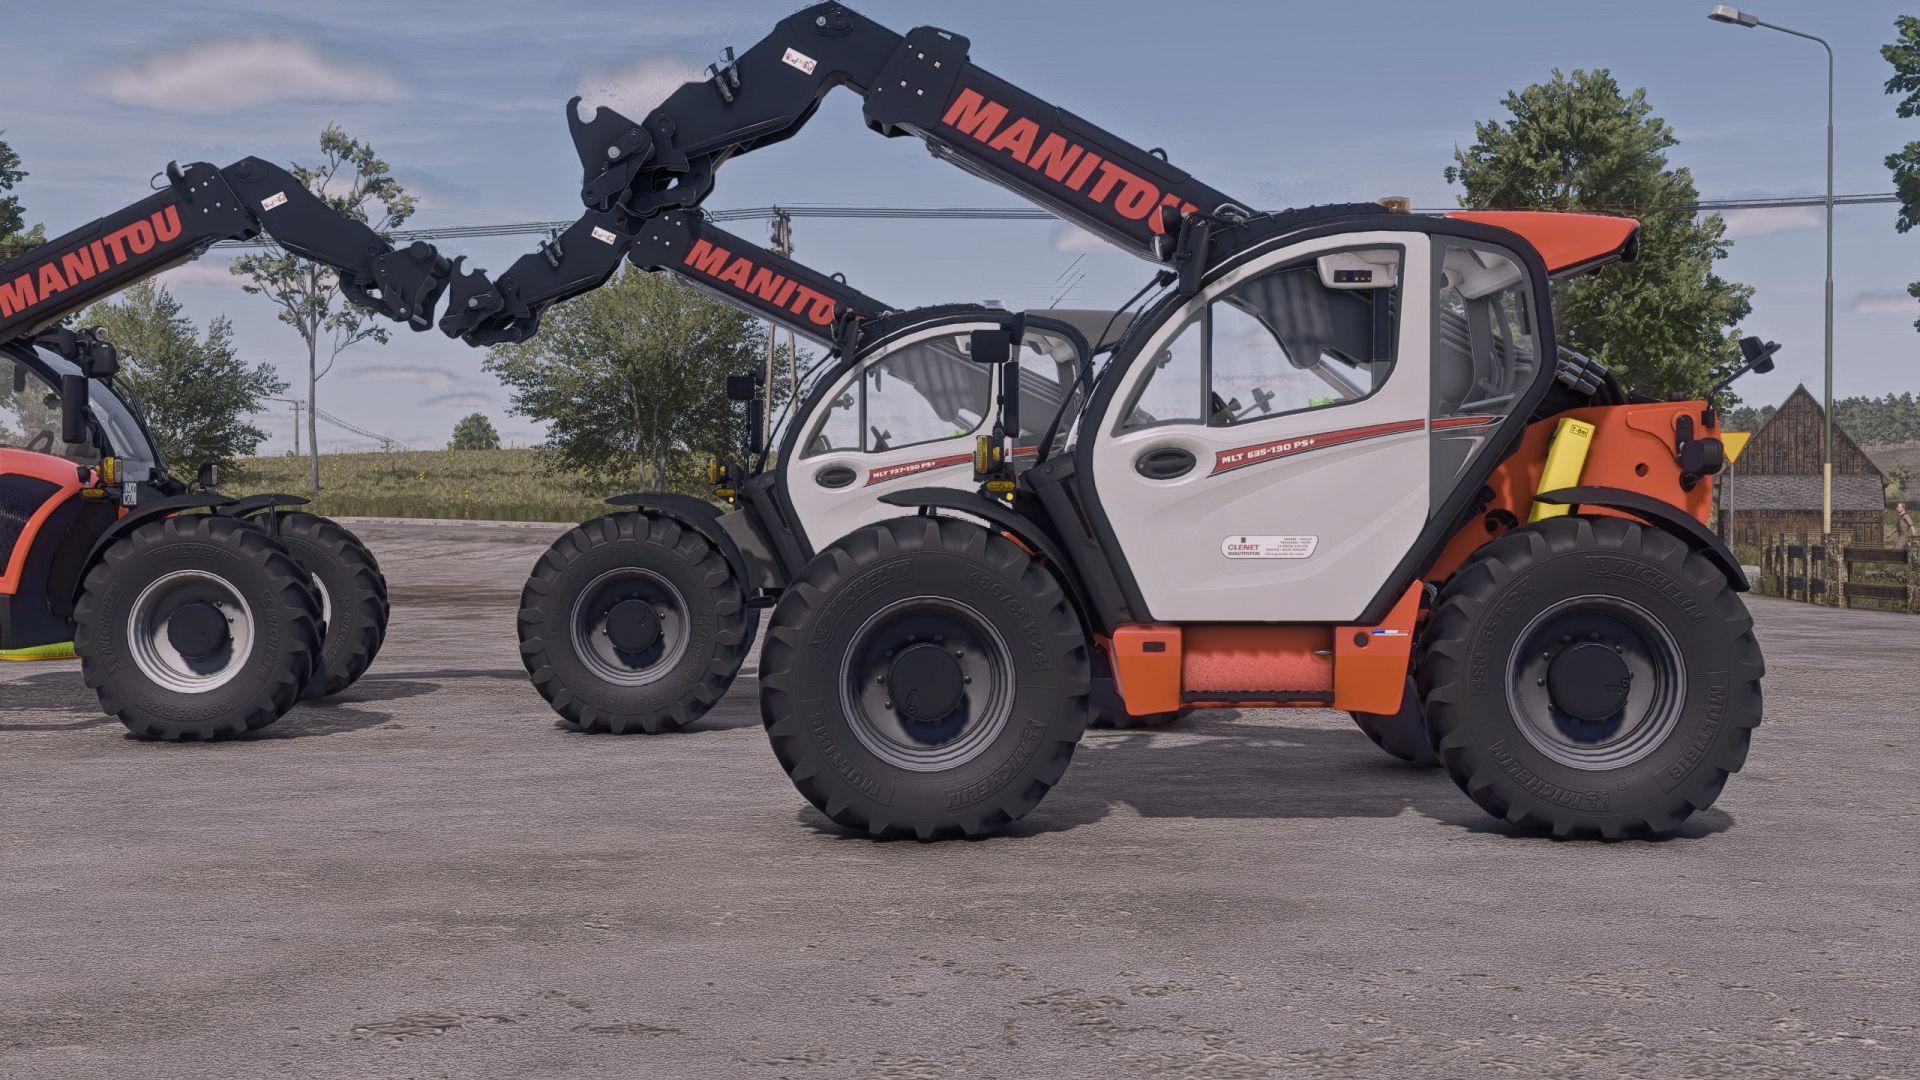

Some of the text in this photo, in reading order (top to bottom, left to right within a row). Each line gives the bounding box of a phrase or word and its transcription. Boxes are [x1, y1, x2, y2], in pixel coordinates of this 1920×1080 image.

[0, 204, 183, 318] MANITOU
[684, 238, 850, 326] MANITO
[873, 470, 889, 478] MLT
[1221, 439, 1315, 464] MLT 635-130 PS+
